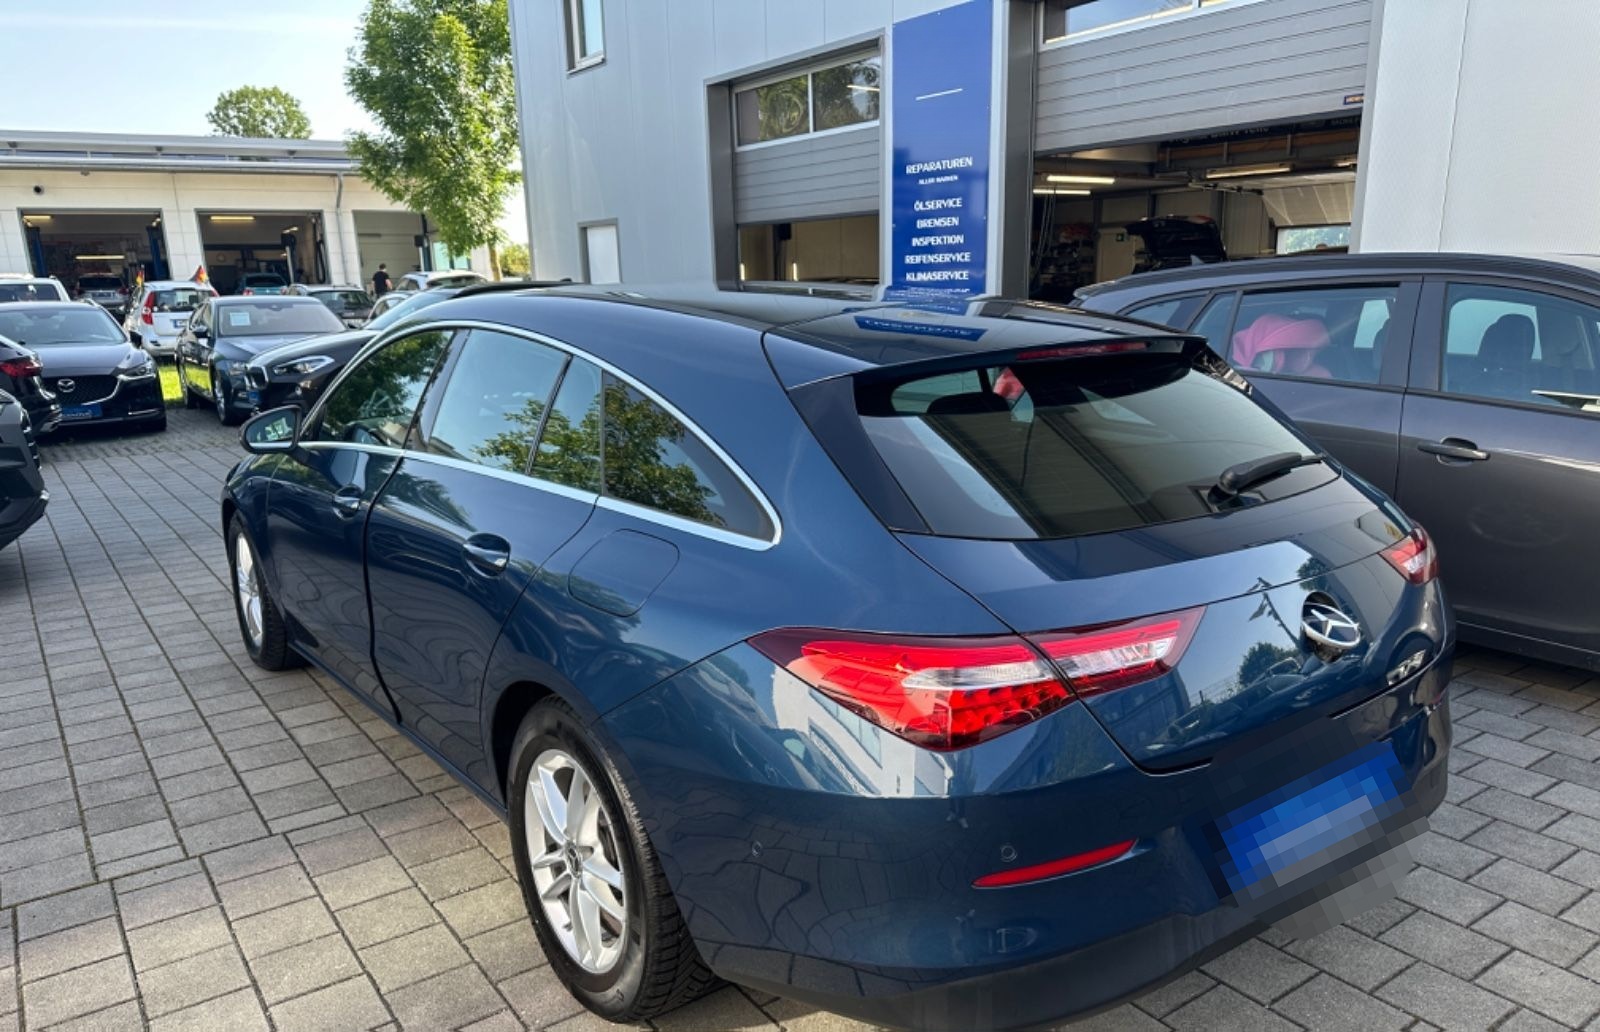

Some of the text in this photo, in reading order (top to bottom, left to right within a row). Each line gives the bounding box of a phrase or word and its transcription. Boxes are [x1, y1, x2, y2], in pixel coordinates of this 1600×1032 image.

[905, 156, 973, 174] REPARATUREN
[913, 197, 963, 212] ÖLSERVICE
[916, 216, 960, 229] BREMSEN
[911, 234, 965, 247] INSPEKTION
[904, 252, 971, 265] REIFENSERVICE
[905, 270, 969, 281] KLIMASERVICE
